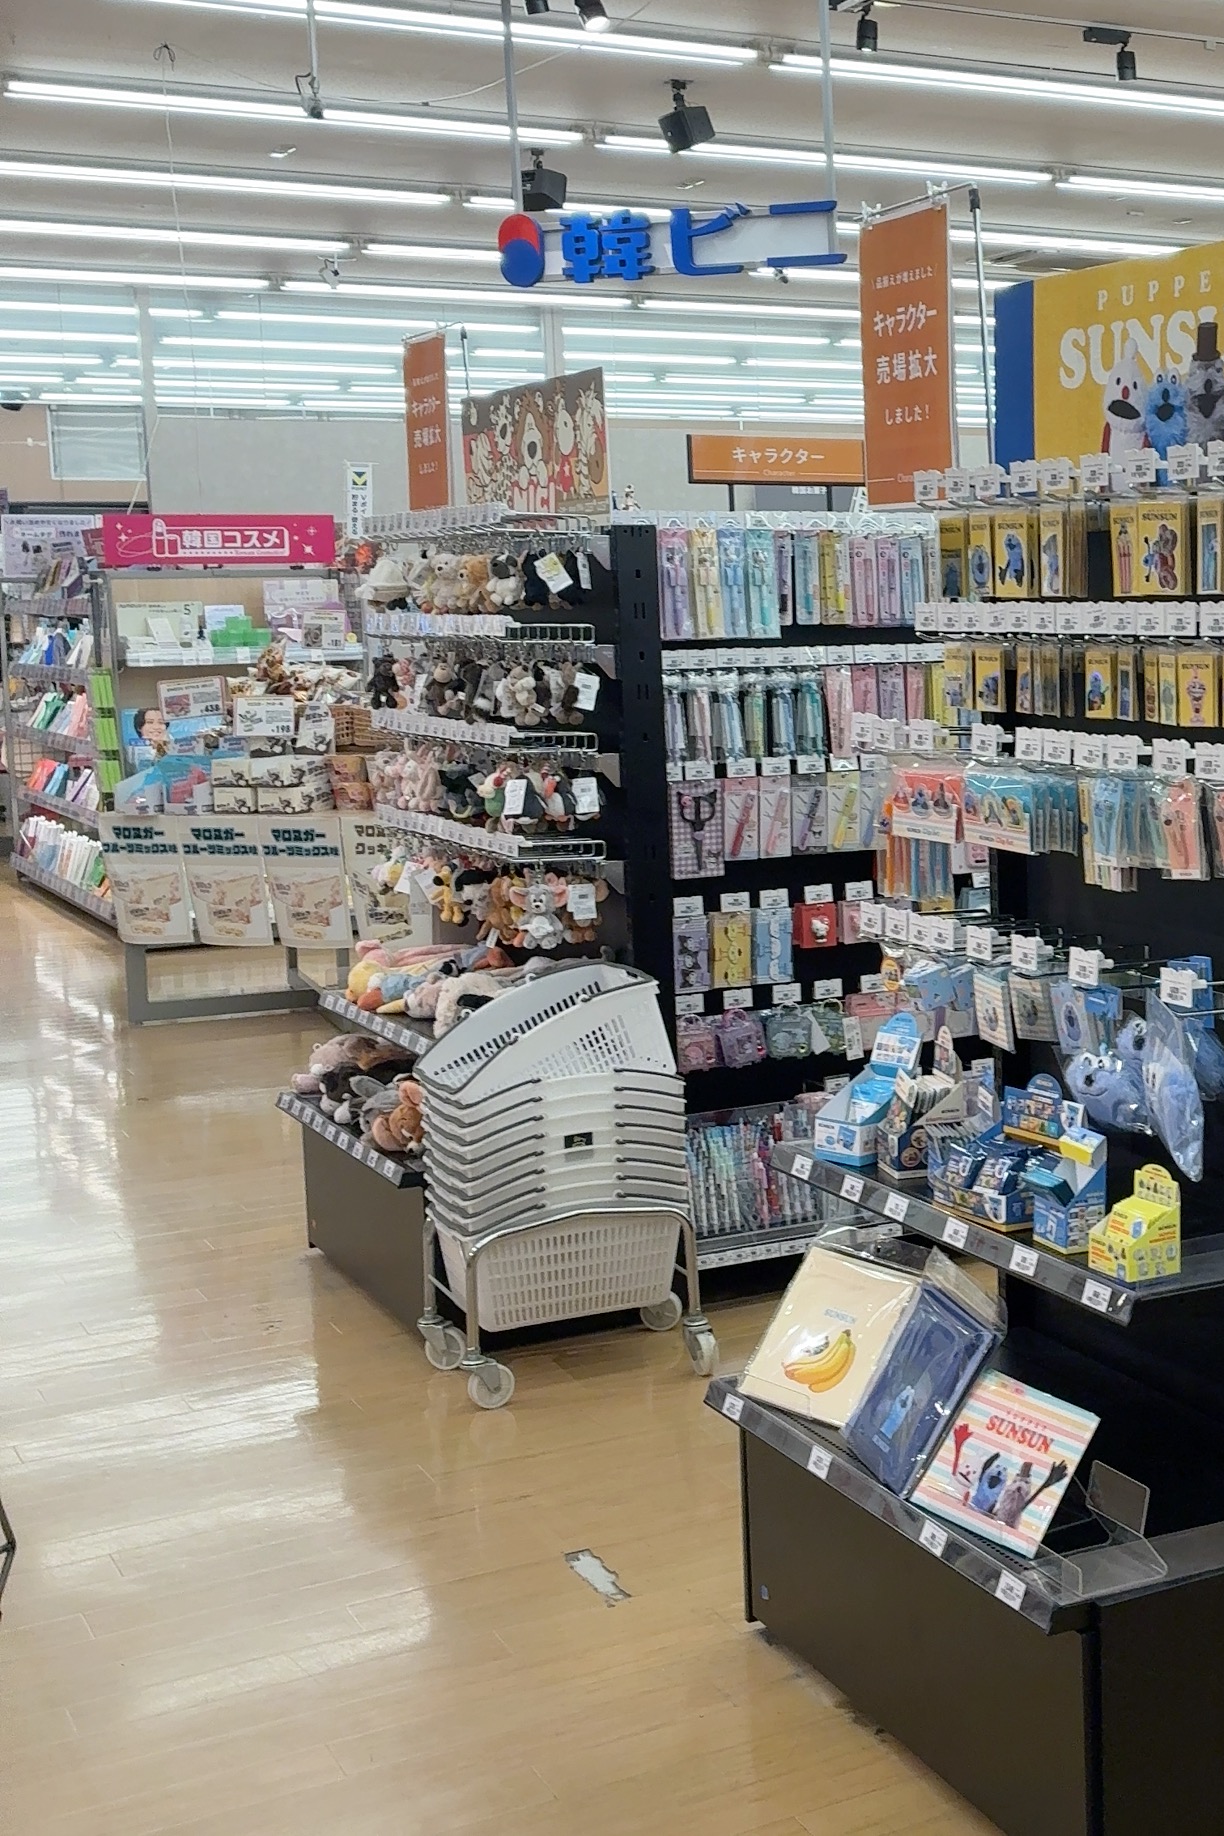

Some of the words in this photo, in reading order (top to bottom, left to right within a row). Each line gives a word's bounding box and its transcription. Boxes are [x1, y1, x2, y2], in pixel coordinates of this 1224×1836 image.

[872, 301, 938, 337] キャラクター
[876, 347, 938, 385] 売場拡大
[732, 446, 826, 464] キャラクター
[1141, 512, 1178, 522] SUNSUN
[181, 529, 281, 548] 韓国コスメ
[985, 1414, 1056, 1455] SUNSUN
